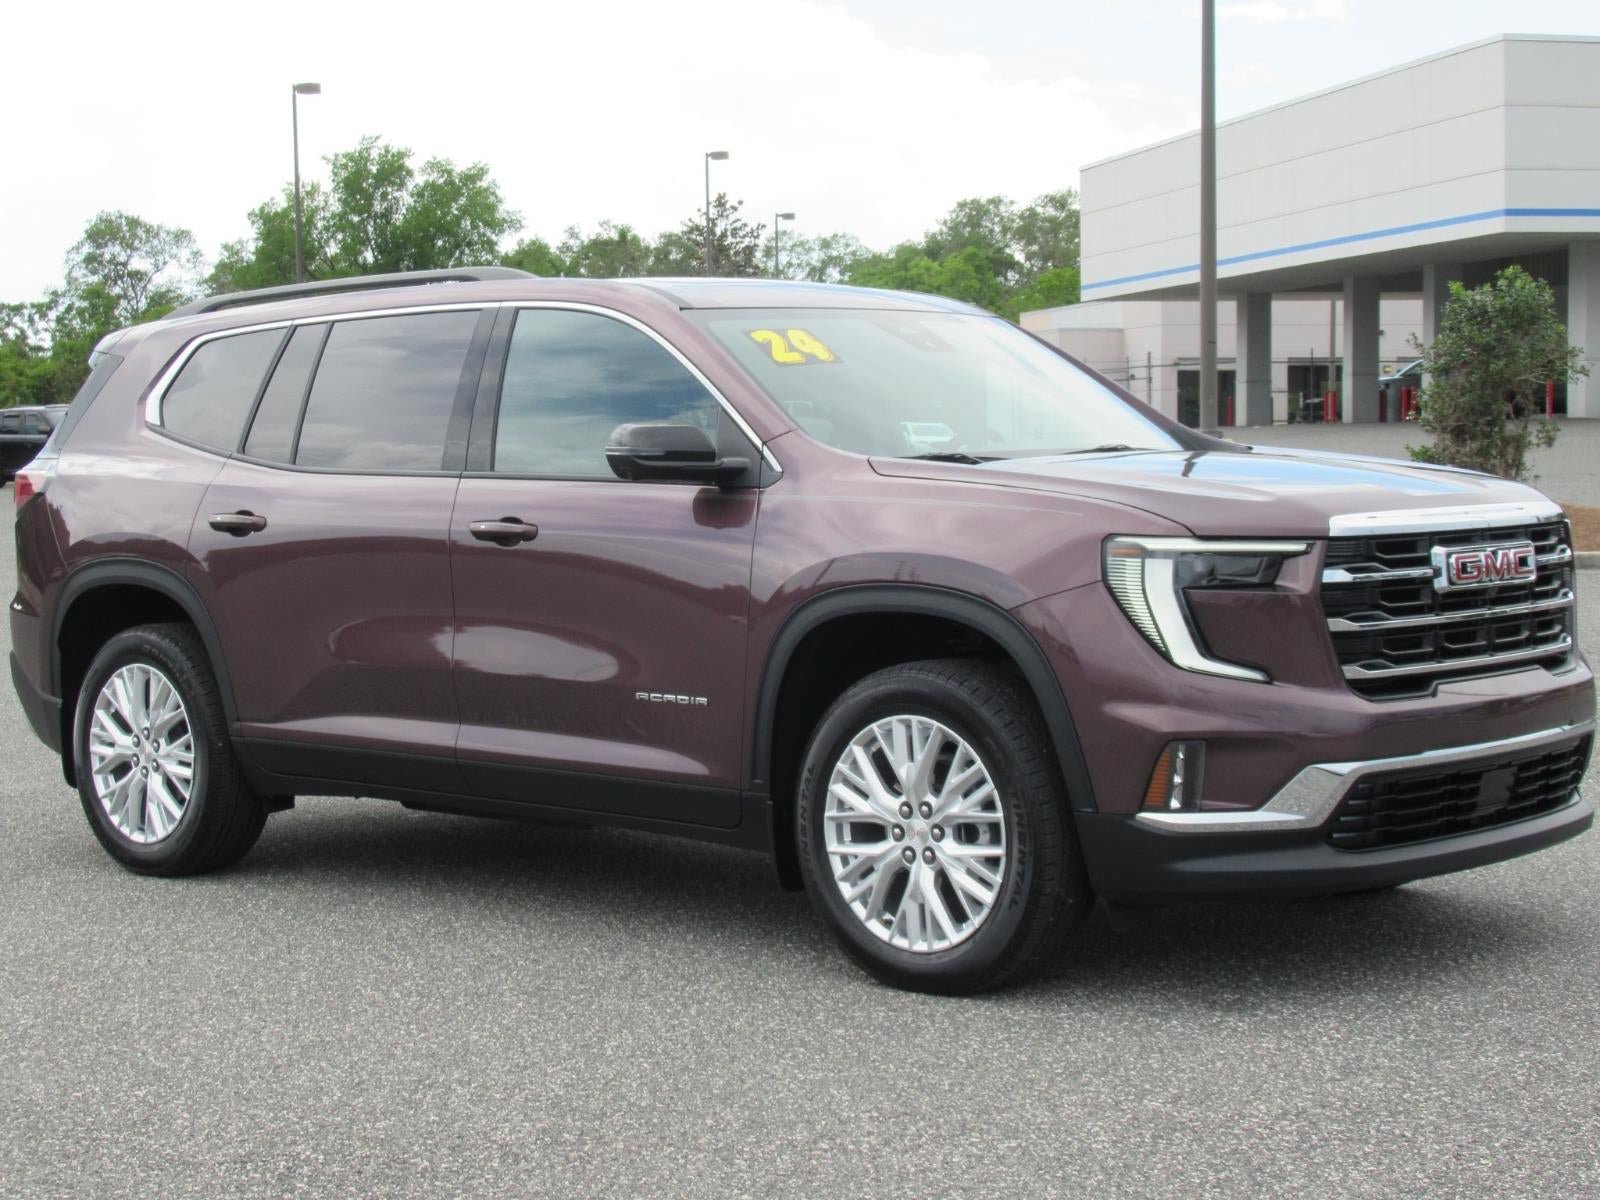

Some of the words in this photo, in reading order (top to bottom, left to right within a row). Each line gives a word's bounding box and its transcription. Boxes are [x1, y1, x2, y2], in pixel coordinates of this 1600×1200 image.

[750, 329, 834, 364] 24
[1449, 548, 1535, 584] GMC
[635, 692, 708, 706] ACADIA
